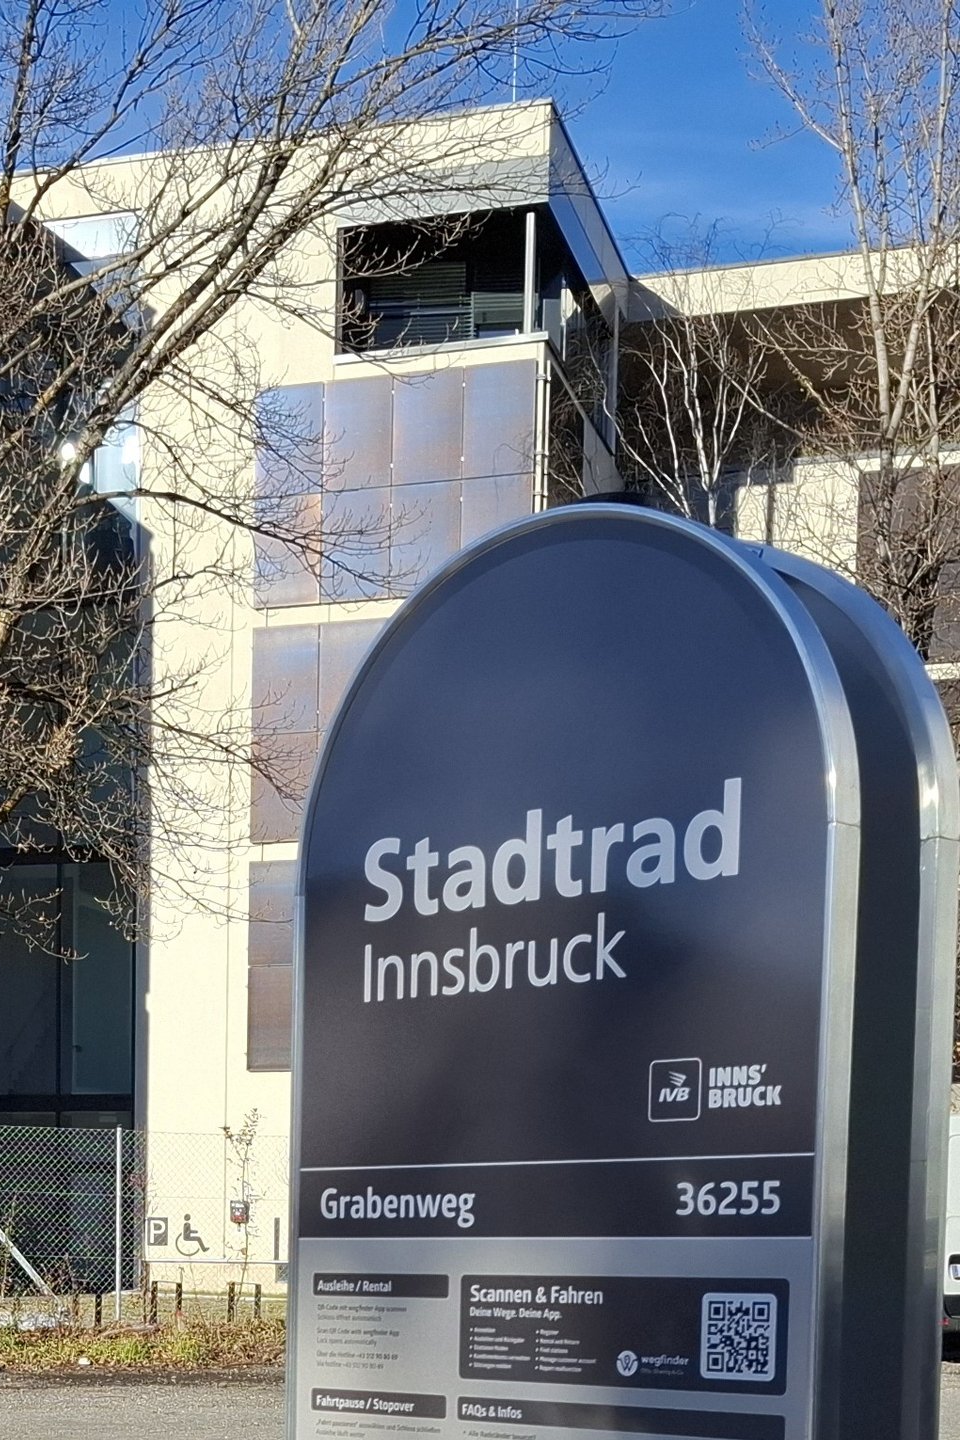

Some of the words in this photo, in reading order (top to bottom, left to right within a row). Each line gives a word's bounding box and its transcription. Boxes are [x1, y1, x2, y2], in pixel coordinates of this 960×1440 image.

[364, 777, 742, 922] Stadtrad
[363, 912, 627, 1003] Innsbruck
[709, 1063, 767, 1088] INNS'
[659, 1087, 690, 1103] IVB
[708, 1085, 782, 1109] BRUCK
[320, 1187, 476, 1228] Grabenweg
[676, 1180, 781, 1216] 36255
[150, 1219, 166, 1244] P
[317, 1280, 355, 1292] Ausleihe
[362, 1280, 392, 1292] Rental
[470, 1284, 532, 1303] Scannen
[535, 1286, 547, 1303] &
[550, 1285, 604, 1304] Fahren
[469, 1306, 492, 1317] Deine
[519, 1308, 542, 1318] Deine
[543, 1309, 563, 1321] App.
[641, 1354, 689, 1367] wegfinder
[316, 1394, 364, 1410] Fahrtpause
[373, 1398, 415, 1412] Stopover
[462, 1403, 487, 1417] FAQs
[487, 1405, 496, 1417] &
[497, 1405, 522, 1419] Infos
